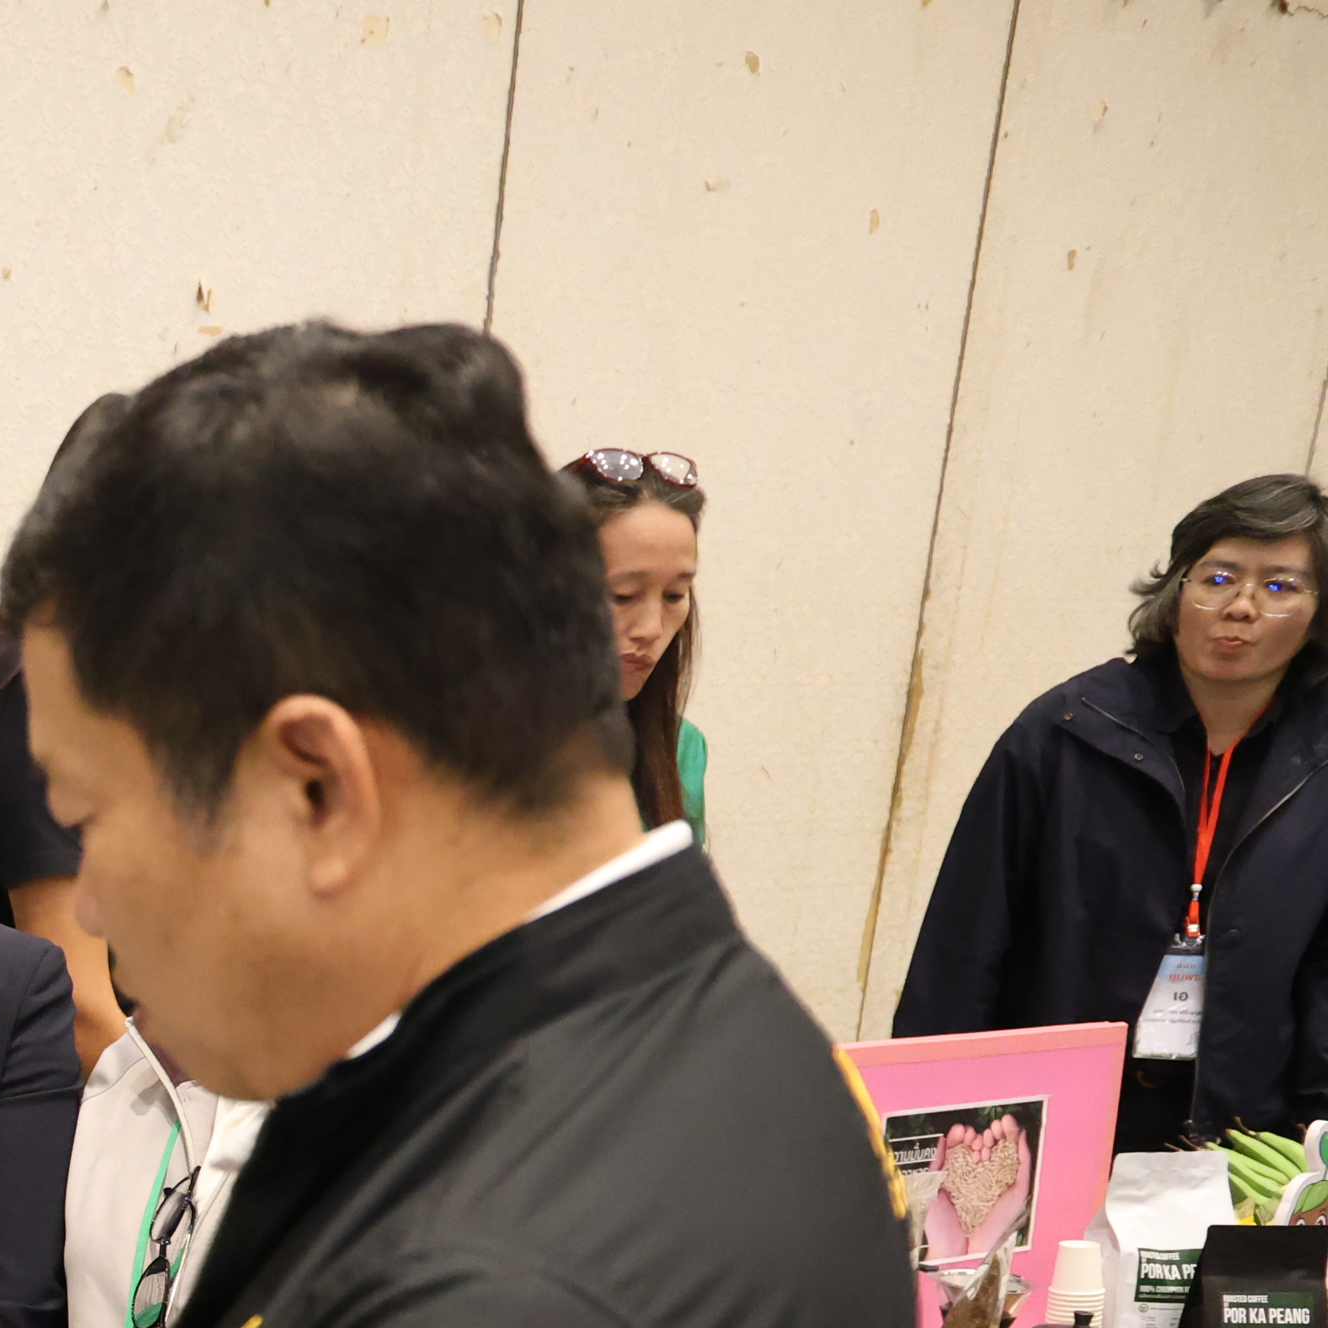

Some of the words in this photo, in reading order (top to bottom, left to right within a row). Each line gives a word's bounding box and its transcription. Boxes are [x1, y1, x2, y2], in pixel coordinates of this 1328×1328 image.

[1140, 1263, 1163, 1279] POR
[1163, 1264, 1181, 1280] KA
[1224, 1307, 1247, 1324] POR
[1249, 1307, 1267, 1324] KA
[1268, 1308, 1311, 1325] PEANG
